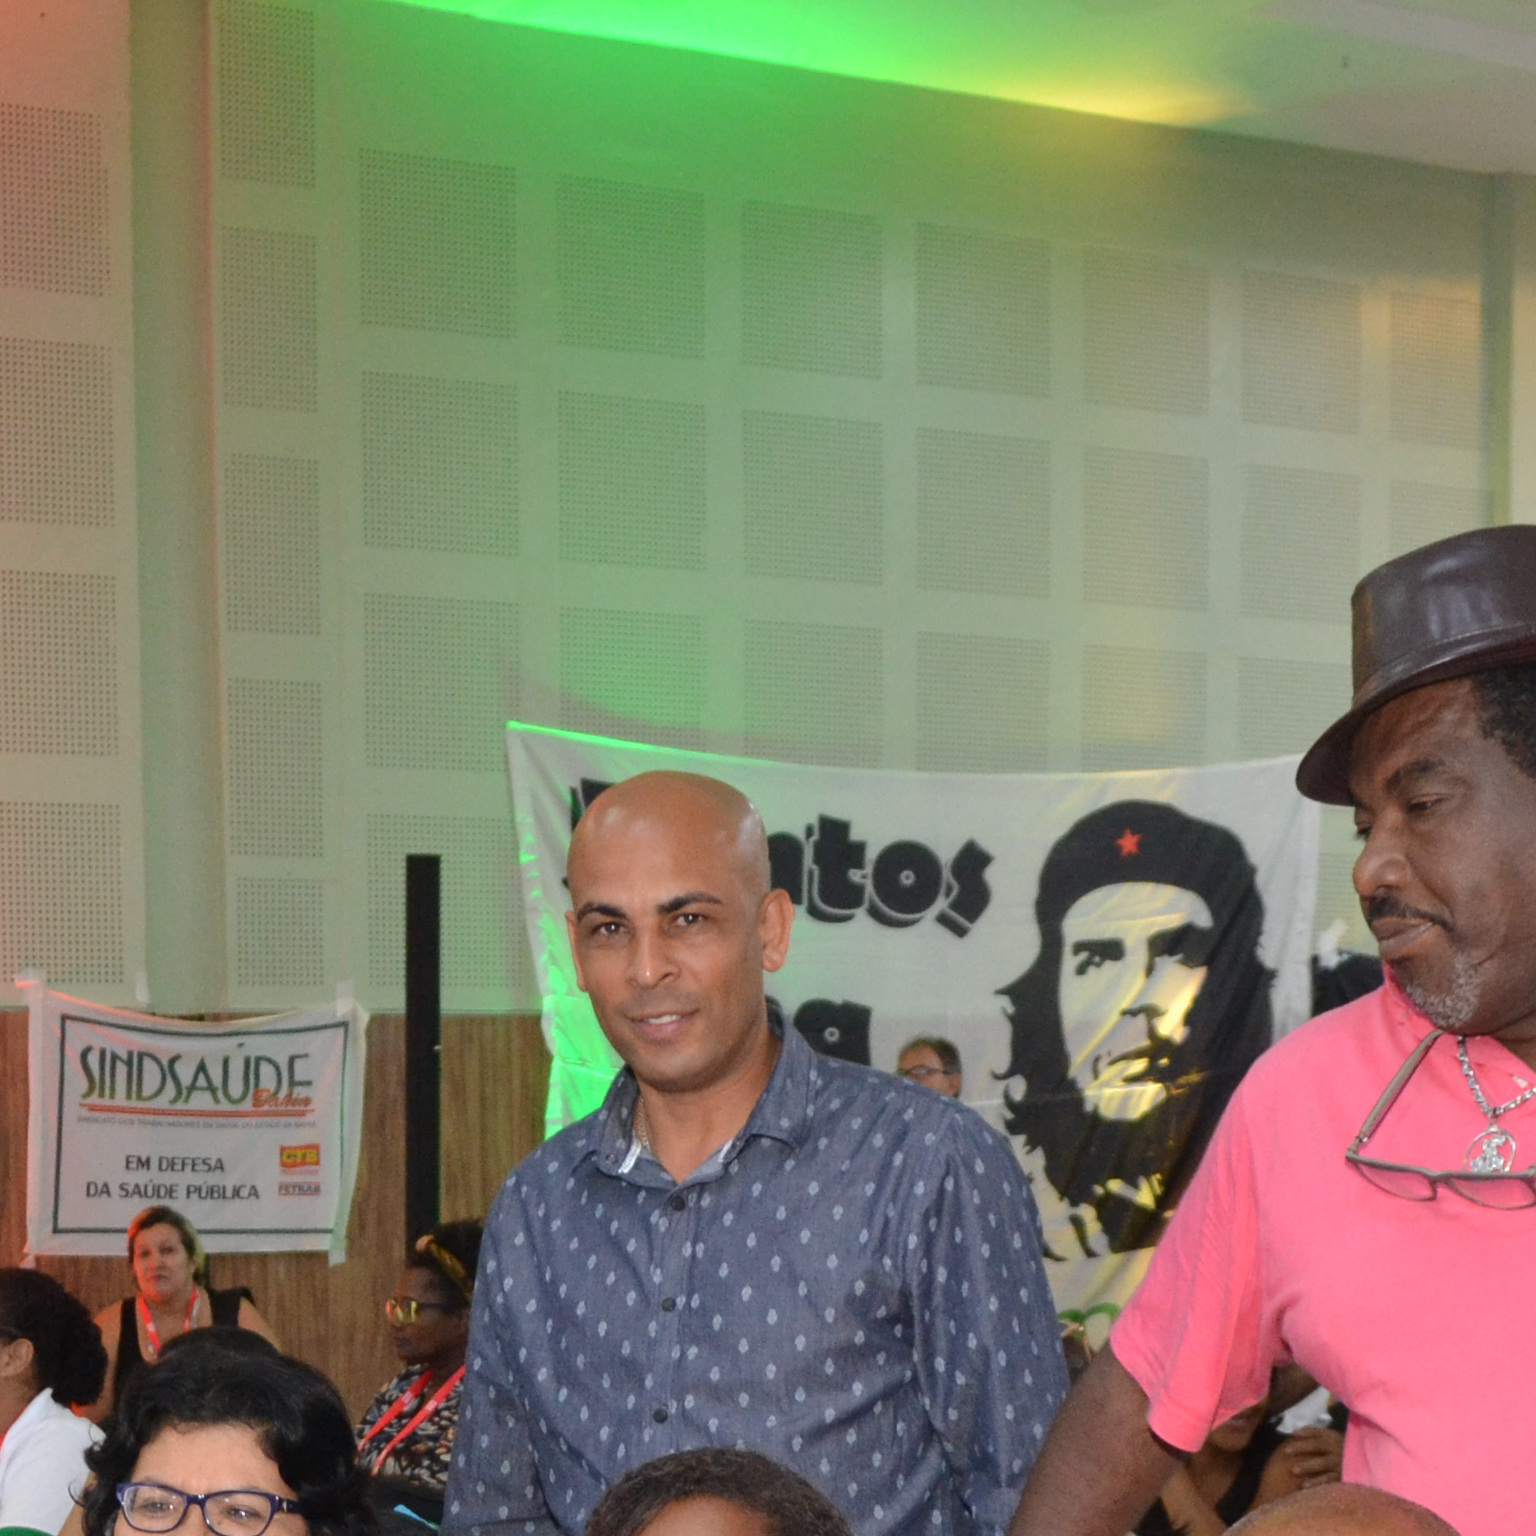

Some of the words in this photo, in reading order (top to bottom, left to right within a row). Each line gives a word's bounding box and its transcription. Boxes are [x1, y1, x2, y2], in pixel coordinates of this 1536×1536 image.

[78, 1042, 313, 1104] SINDSAÚDE
[125, 1154, 151, 1172] EM
[158, 1156, 225, 1173] DEFESA
[86, 1181, 111, 1198] DA
[118, 1179, 179, 1199] SAÚDE
[186, 1180, 260, 1200] PÚBLICA
